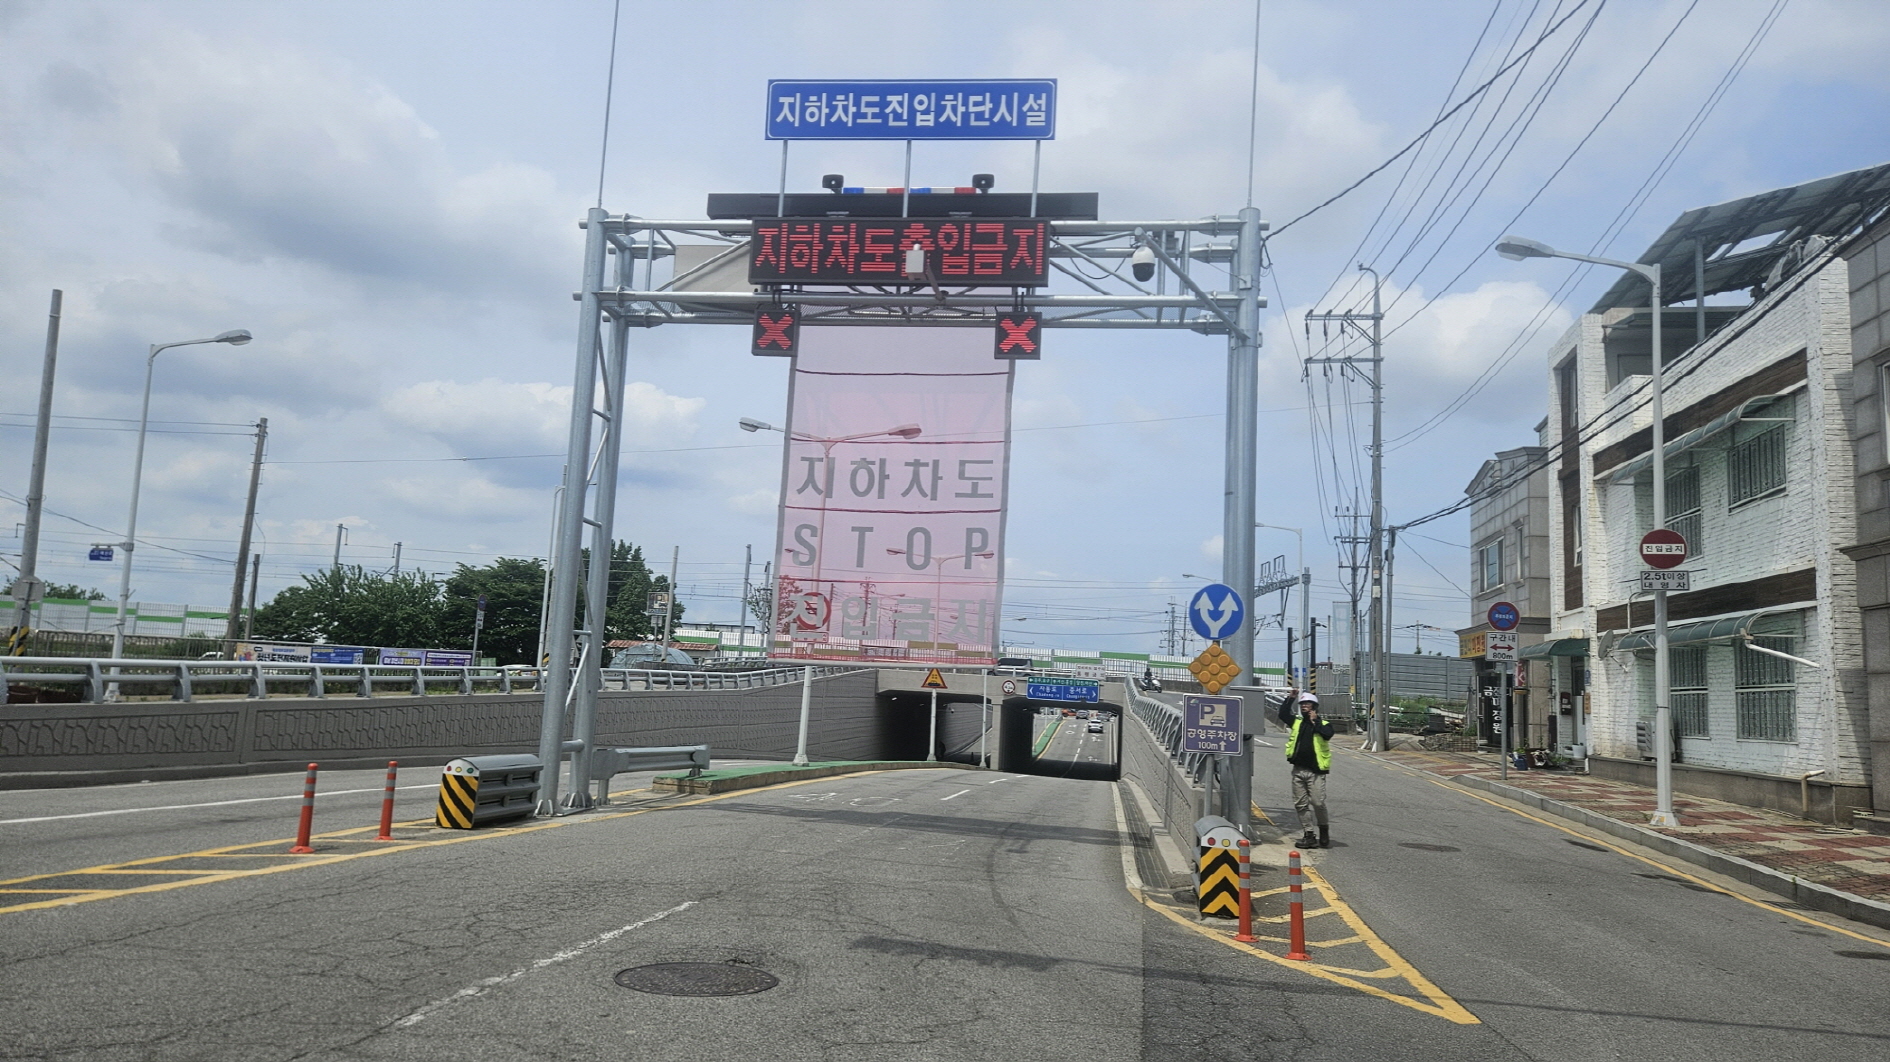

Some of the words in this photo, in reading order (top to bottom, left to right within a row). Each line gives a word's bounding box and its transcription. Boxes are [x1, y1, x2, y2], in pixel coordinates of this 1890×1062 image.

[776, 92, 1047, 126] 지하차도진입차단시설
[755, 223, 1044, 276] 지하차도출입금지
[796, 456, 994, 501] 지하차도
[791, 523, 989, 570] STOP
[1645, 545, 1683, 553] 진입금지
[782, 593, 987, 643] 진입금지
[1492, 652, 1513, 660] 800m
[1187, 728, 1237, 741] 공영주차장
[1198, 741, 1218, 750] 100m
